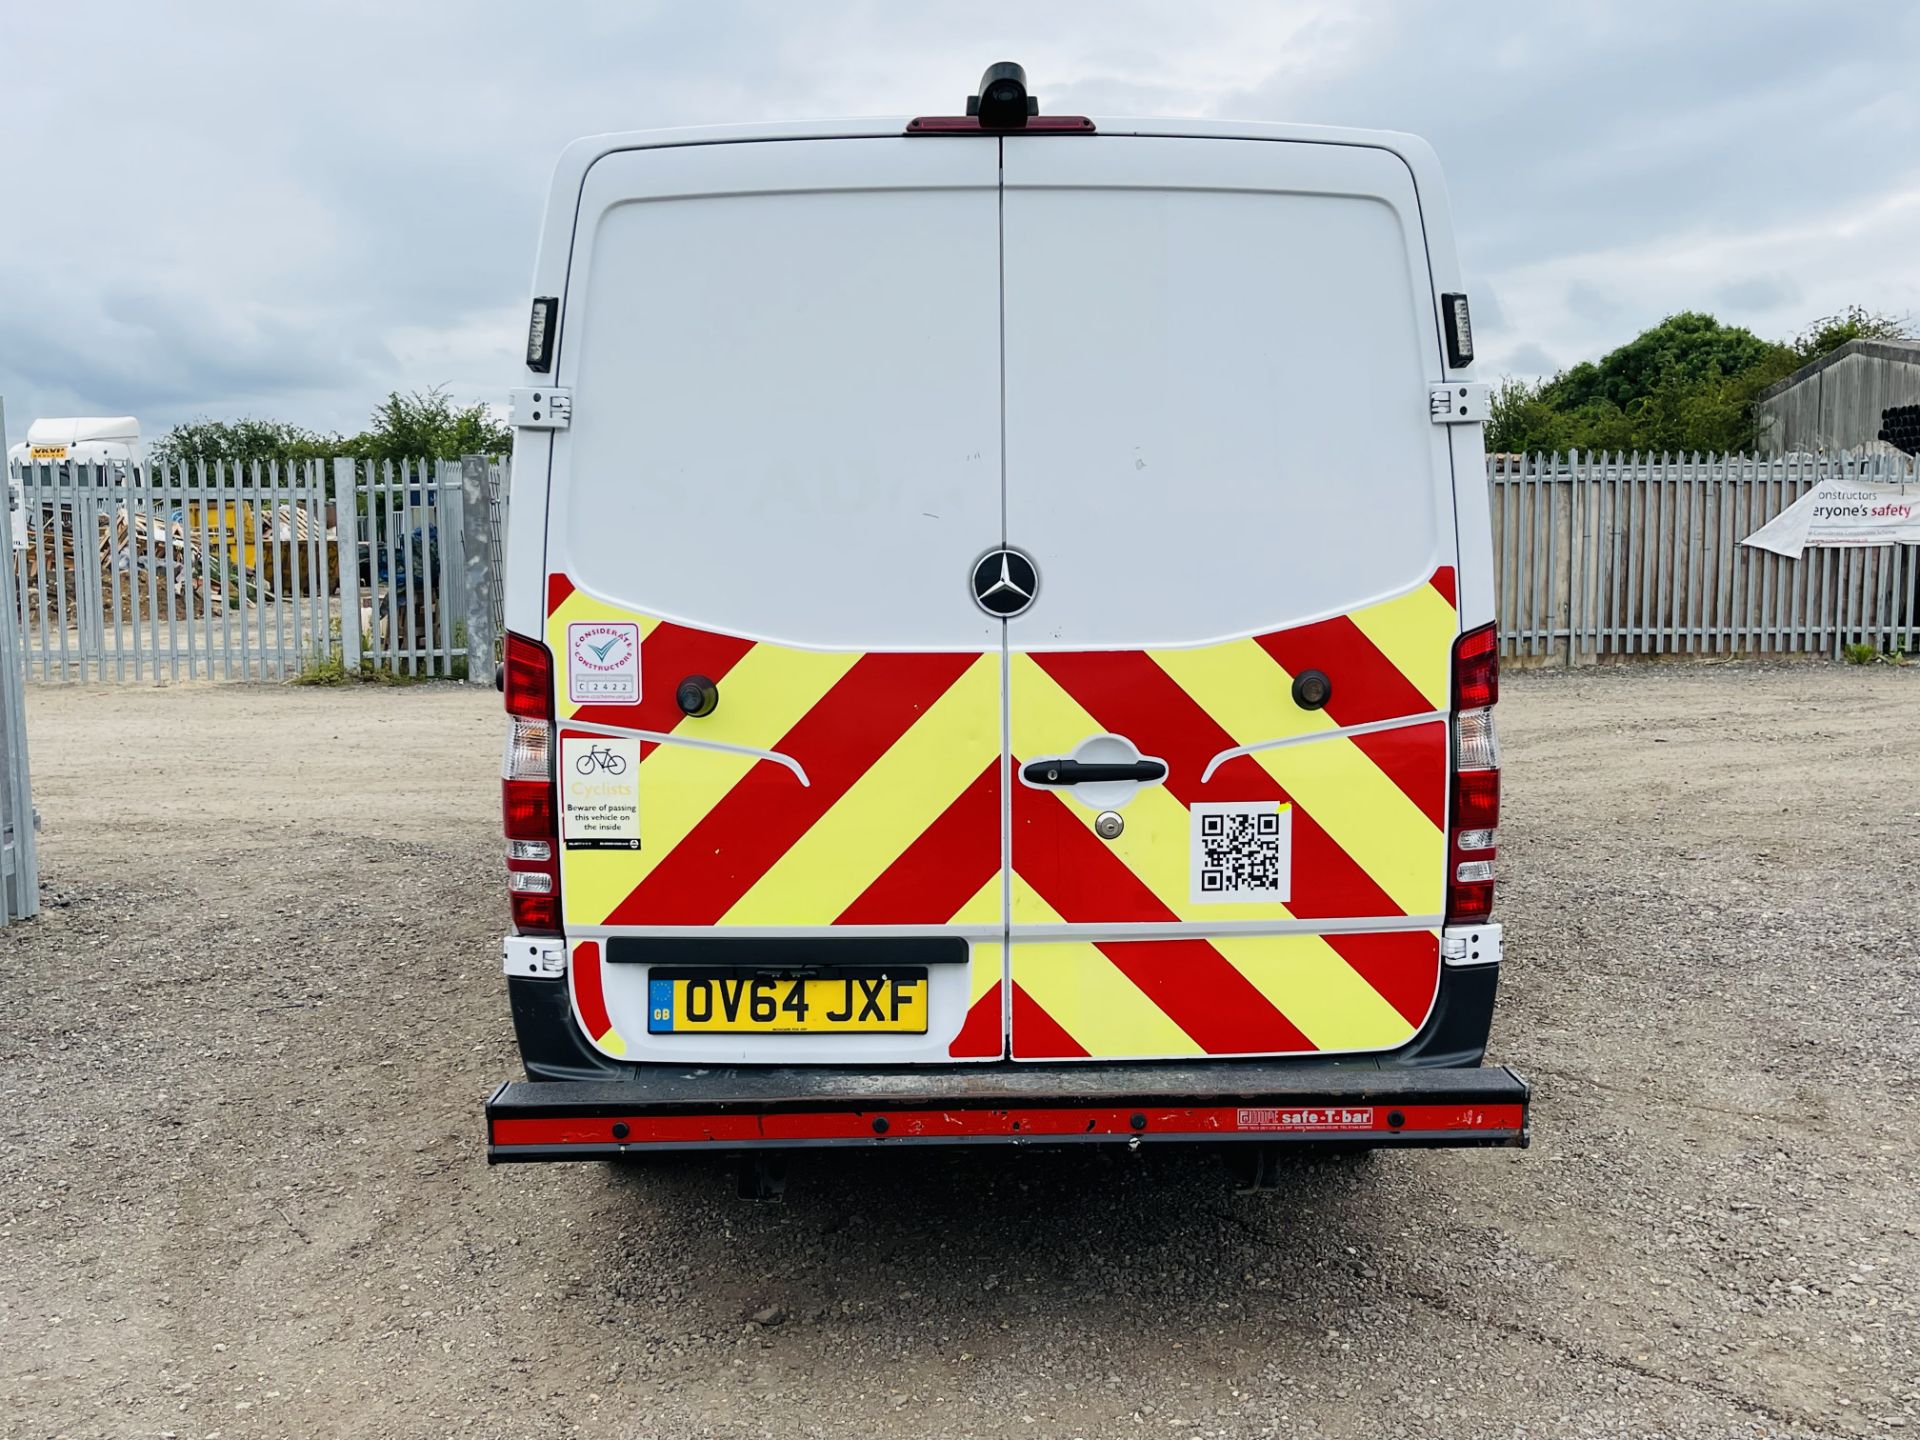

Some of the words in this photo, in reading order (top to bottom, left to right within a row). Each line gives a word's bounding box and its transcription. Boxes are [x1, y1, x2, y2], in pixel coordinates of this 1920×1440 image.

[1871, 503, 1912, 518] safety
[574, 627, 633, 648] CONSIDERATE
[574, 651, 633, 672] CONSTRUCTORS
[572, 782, 632, 800] Cyclists
[567, 804, 597, 812] Beware
[599, 804, 607, 812] of
[608, 804, 637, 814] passing
[686, 980, 809, 1022] OV64
[826, 980, 918, 1022] JXF
[653, 1009, 670, 1020] GB
